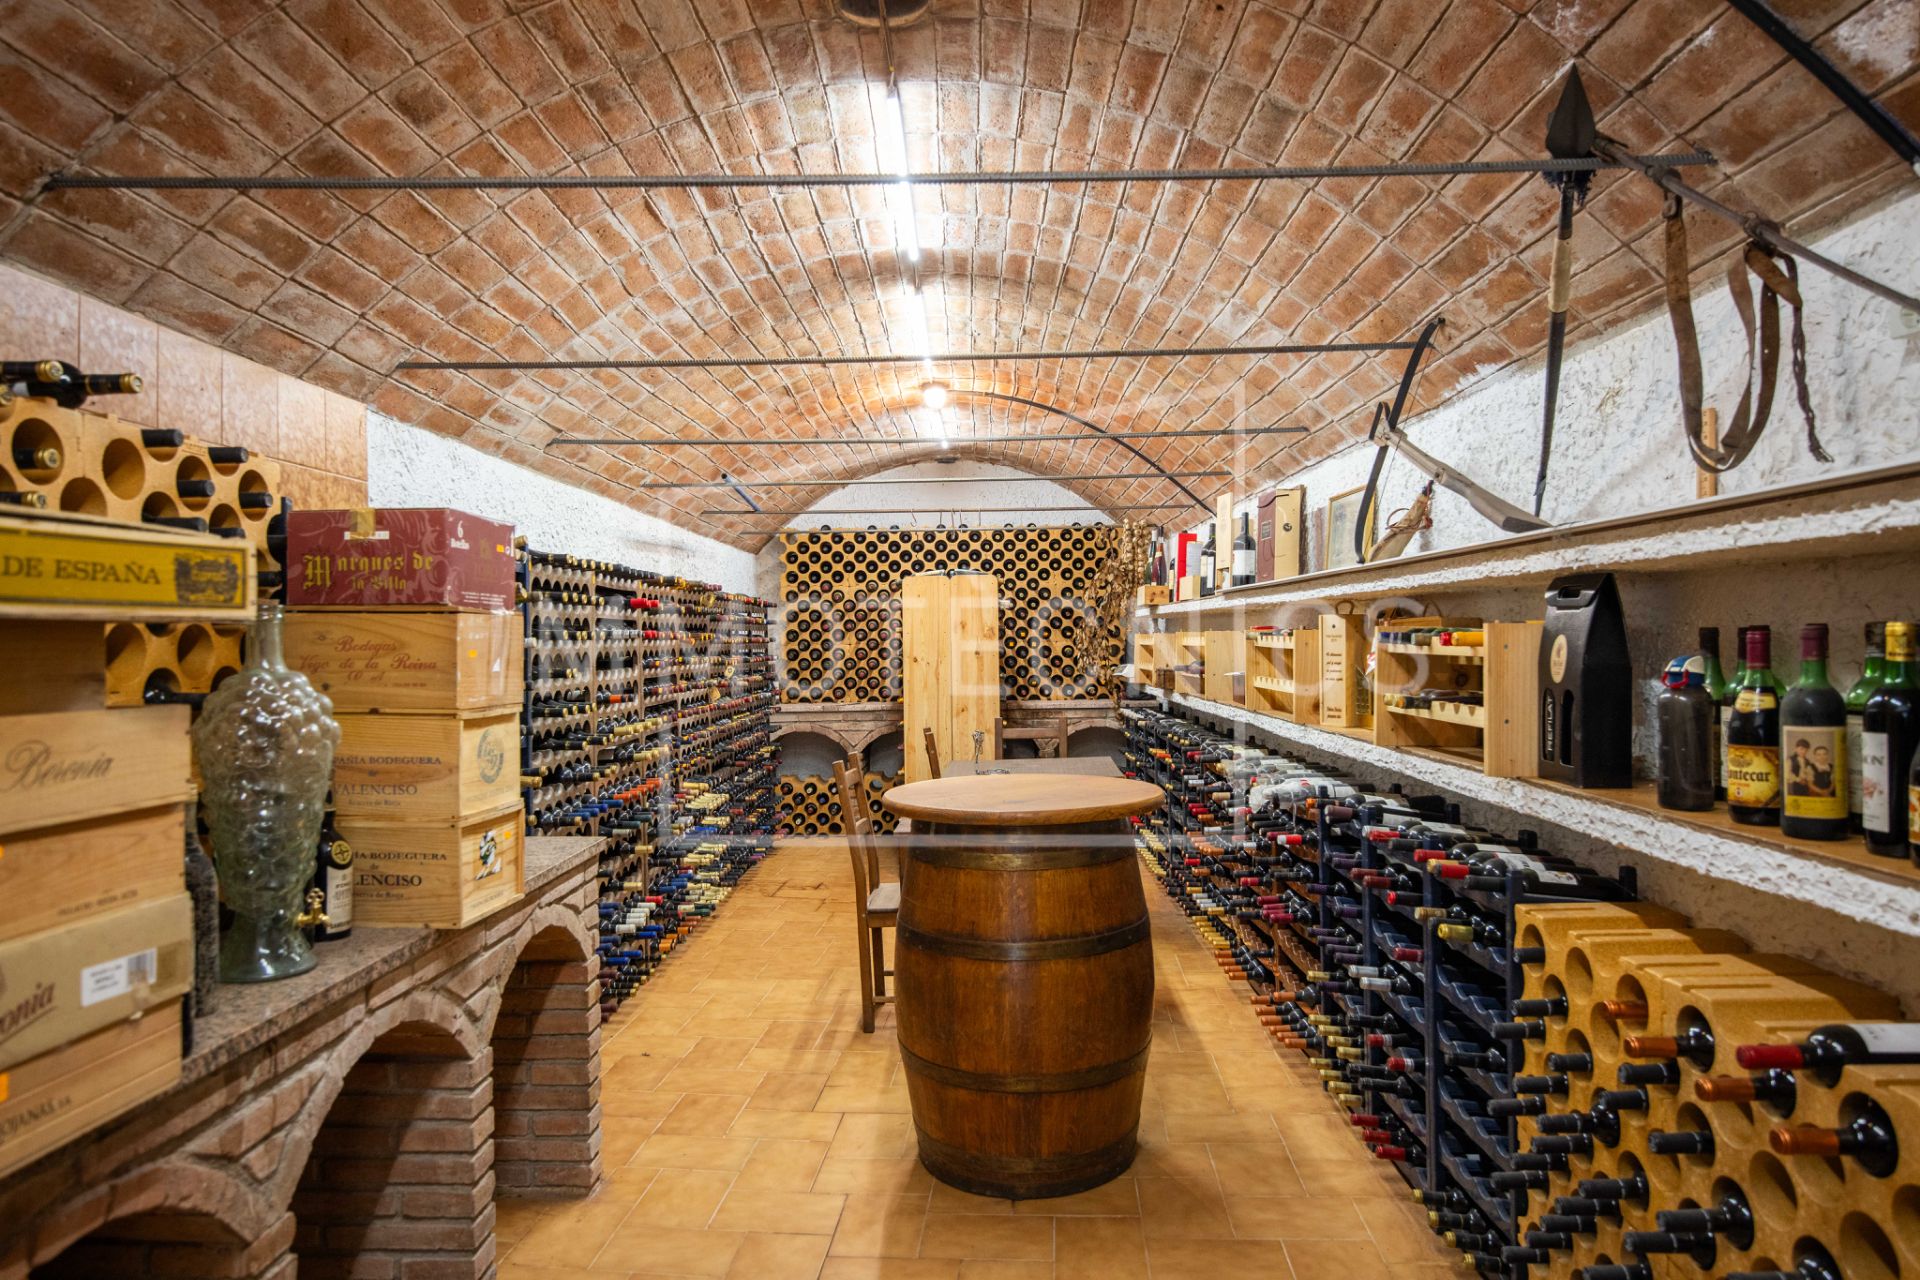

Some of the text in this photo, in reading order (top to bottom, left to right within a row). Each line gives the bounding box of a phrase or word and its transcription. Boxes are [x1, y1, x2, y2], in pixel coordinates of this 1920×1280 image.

[457, 520, 464, 538] 6
[3, 555, 162, 585] DE ESPAÑA
[303, 550, 433, 589] Marqués de
[335, 635, 397, 656] Bodegas
[338, 657, 354, 669] de
[365, 657, 380, 669] la
[391, 653, 438, 670] Reina
[369, 756, 442, 765] BODEGUERA
[370, 852, 448, 861] BODEGUERA
[355, 874, 422, 886] ENCISO
[0, 982, 56, 1034] onia
